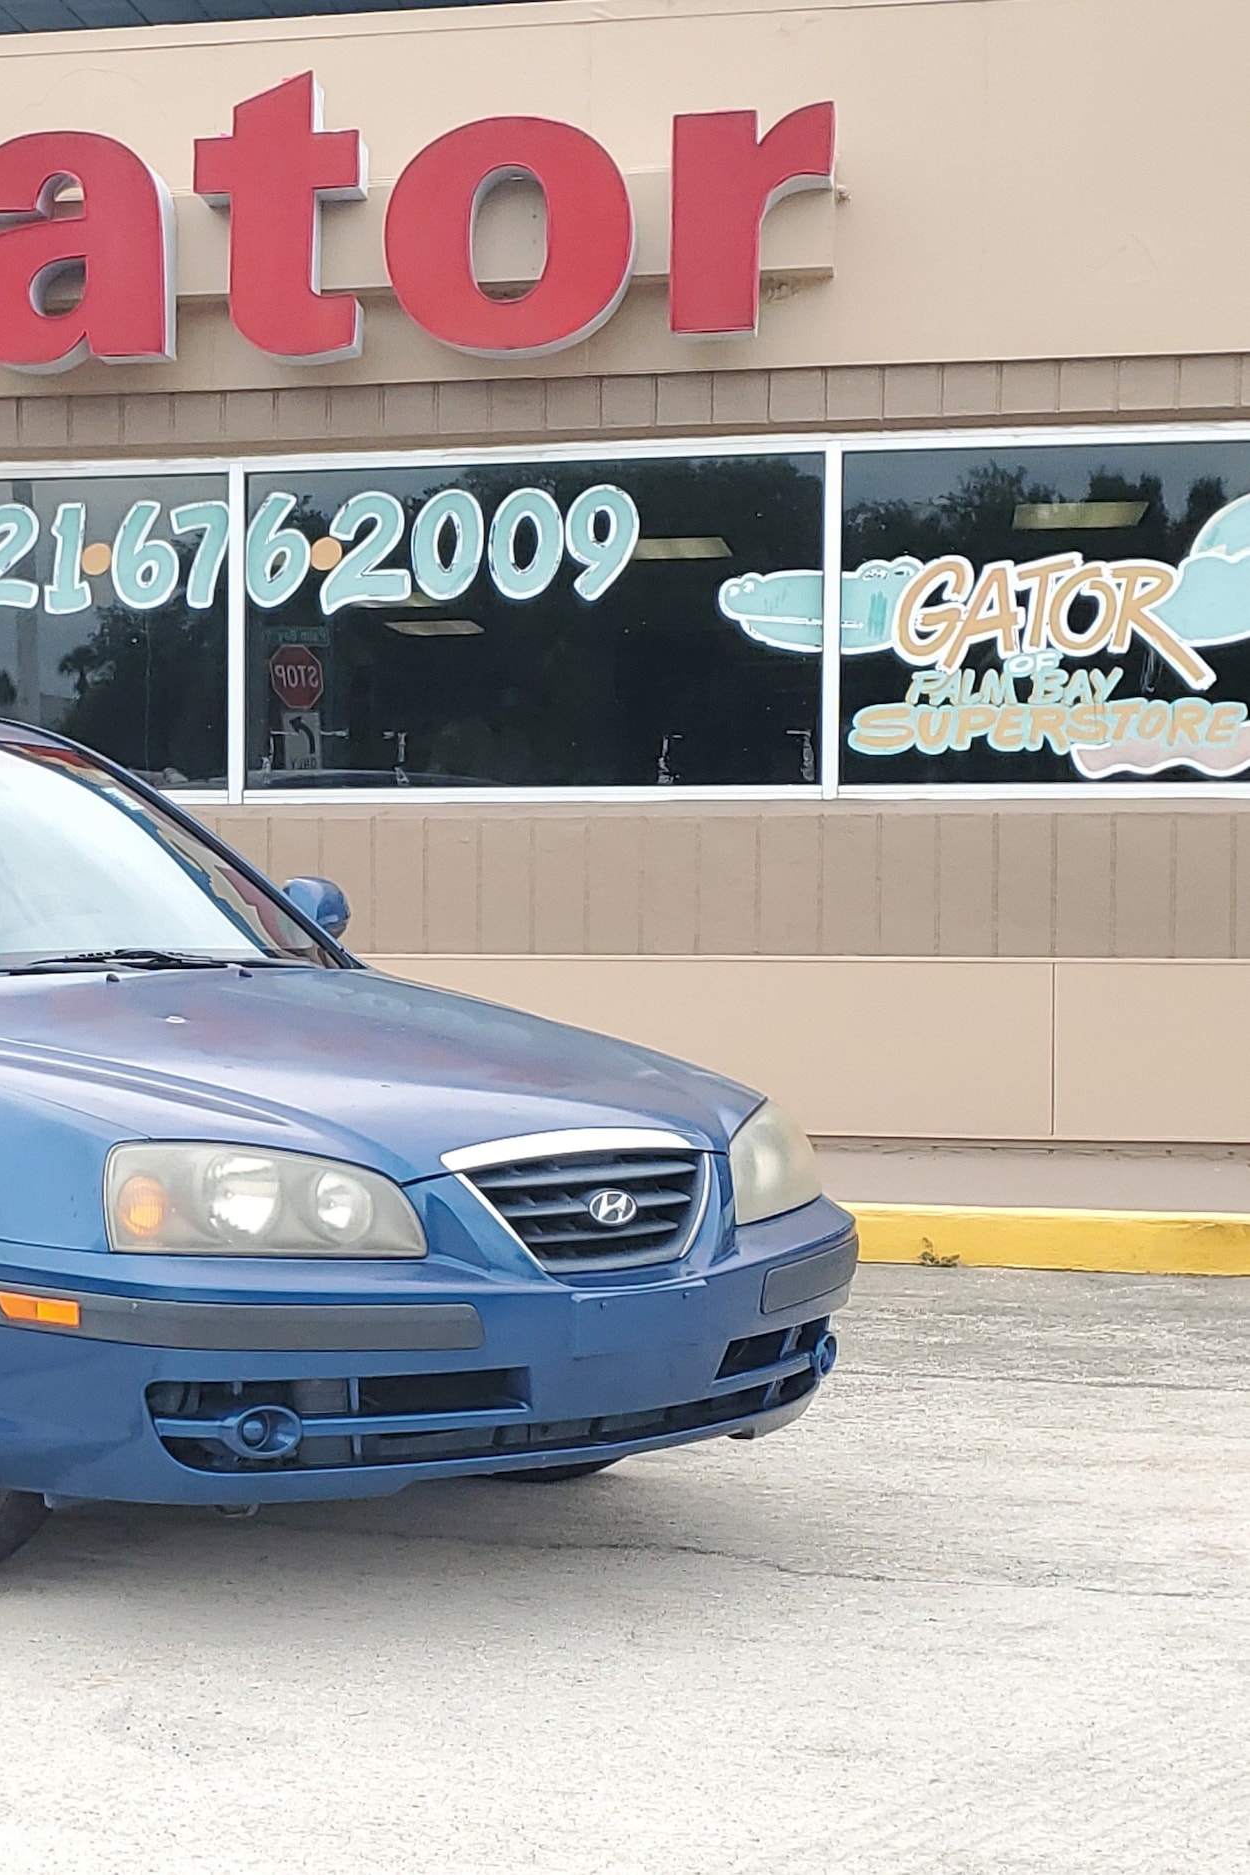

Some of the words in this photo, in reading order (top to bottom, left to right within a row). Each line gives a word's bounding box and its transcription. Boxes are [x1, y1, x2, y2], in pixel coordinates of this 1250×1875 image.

[893, 551, 1216, 691] GATOR
[906, 667, 1018, 706] PALM
[1028, 667, 1124, 706] BAY
[1004, 652, 1064, 677] OF
[849, 697, 1248, 756] SUPERSTORE
